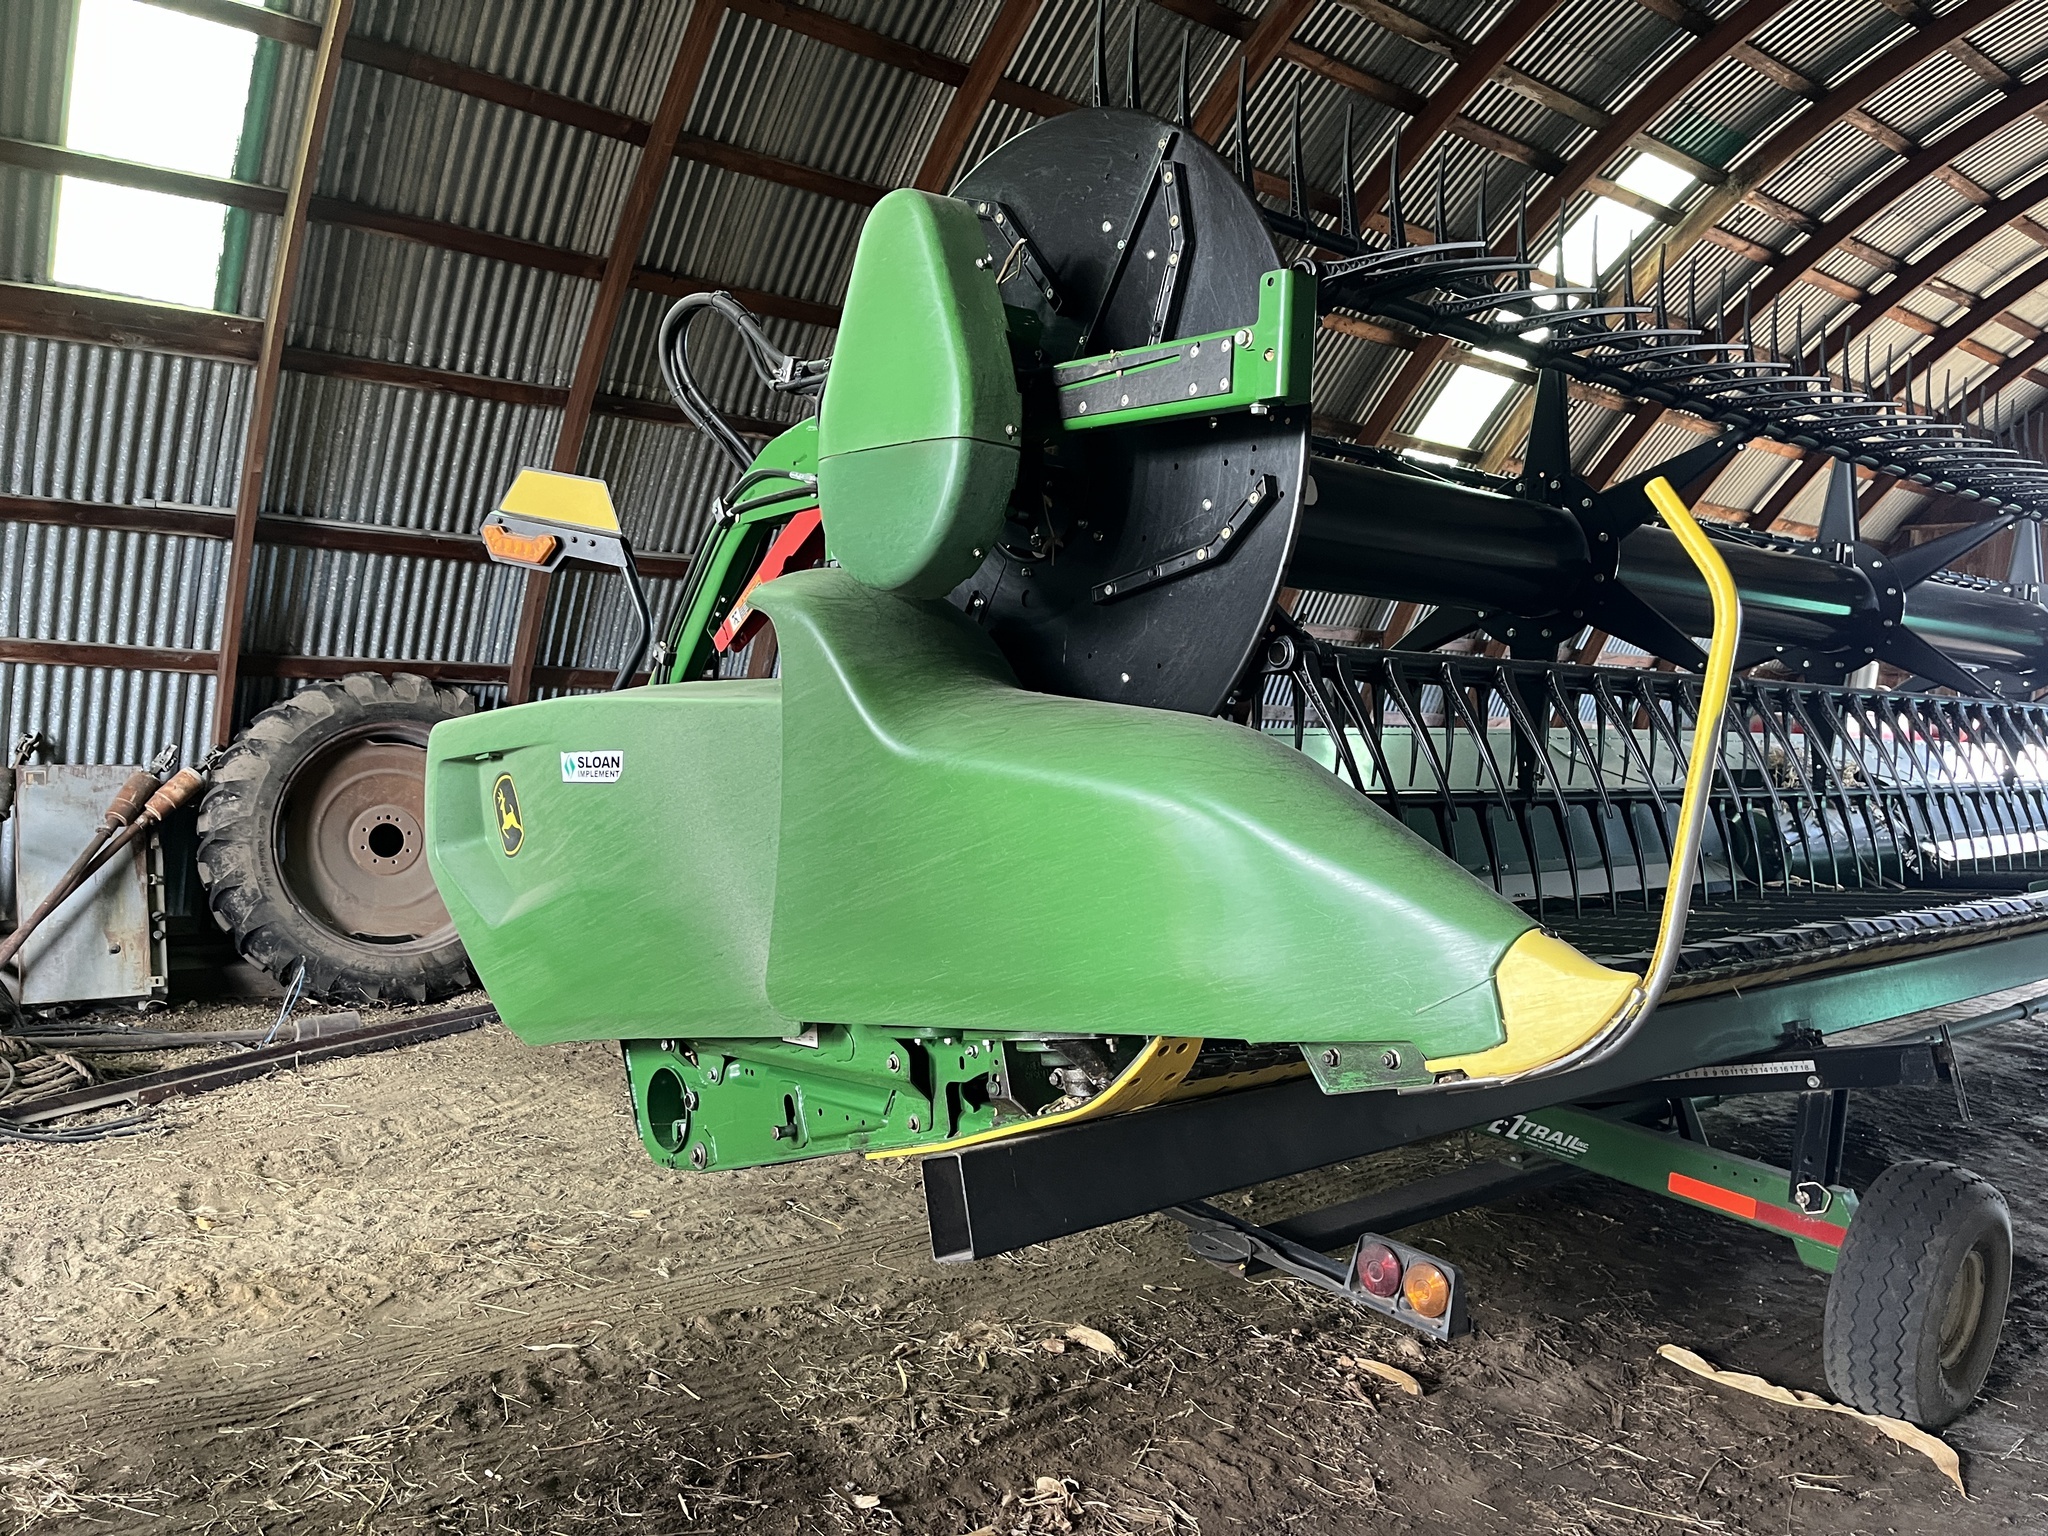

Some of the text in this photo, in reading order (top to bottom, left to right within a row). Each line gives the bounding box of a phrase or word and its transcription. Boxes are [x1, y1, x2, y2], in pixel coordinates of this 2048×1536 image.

[577, 756, 620, 769] SLOAN
[577, 770, 620, 778] IMPLEMENT
[1521, 1121, 1587, 1153] TRAIL
